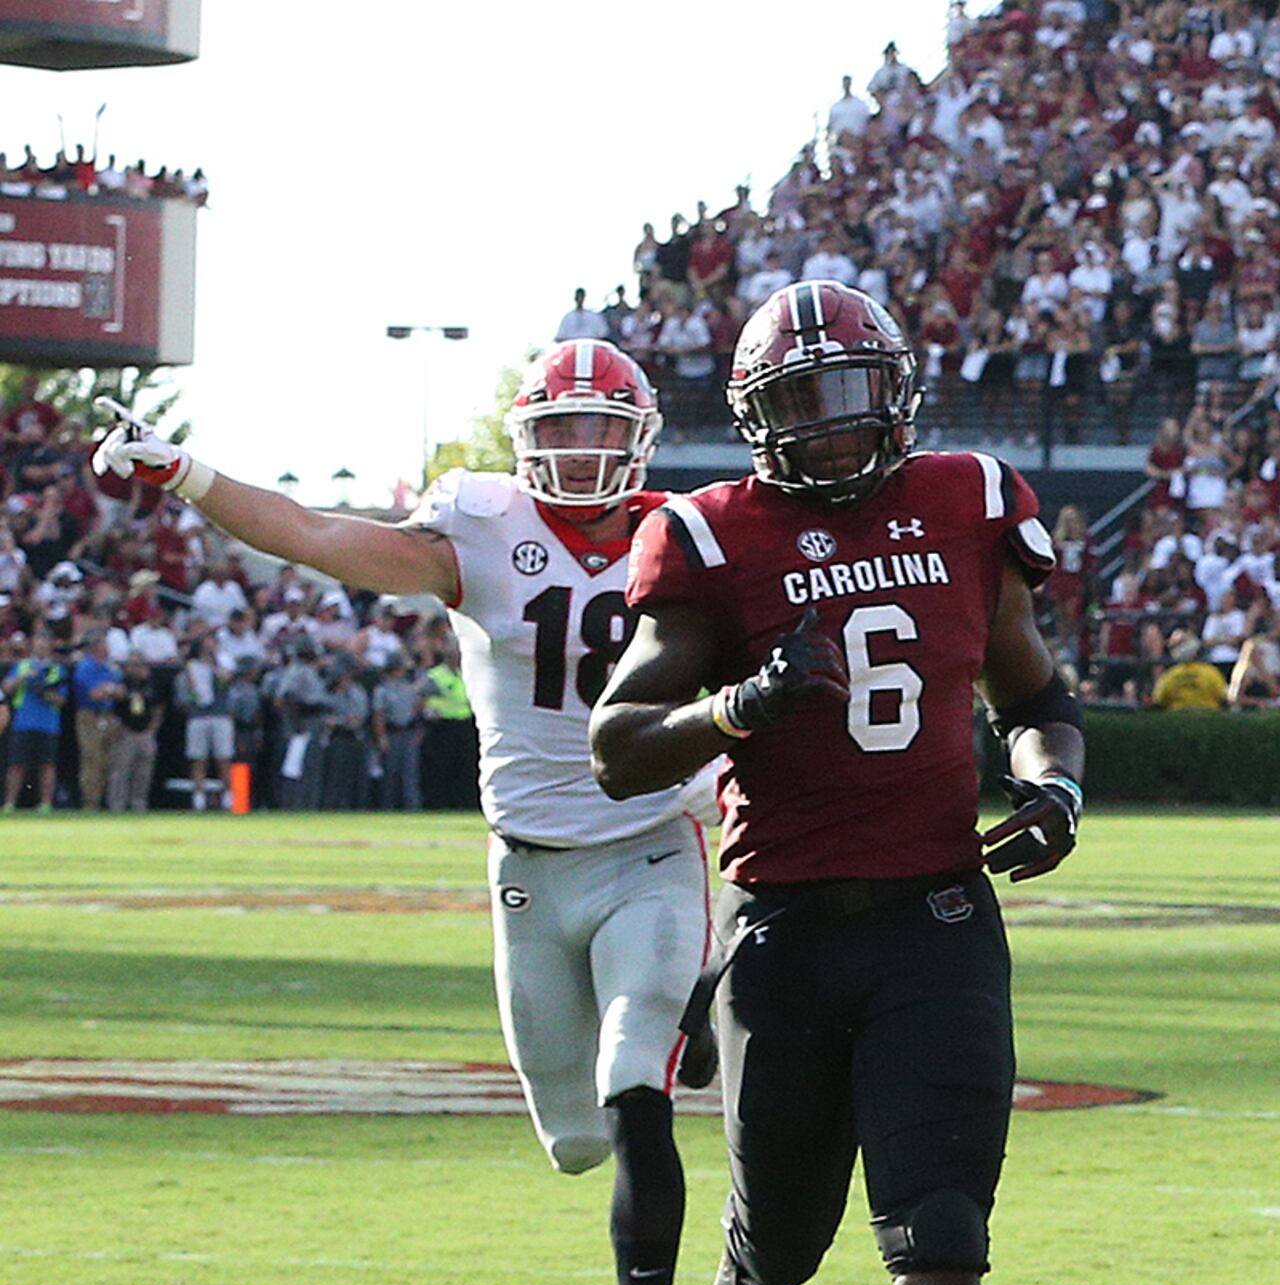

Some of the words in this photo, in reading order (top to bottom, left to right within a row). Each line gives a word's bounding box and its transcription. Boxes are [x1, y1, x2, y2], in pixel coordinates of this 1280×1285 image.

[801, 531, 835, 558] SEC
[783, 552, 950, 605] CAROLINA
[843, 603, 924, 752] 6
